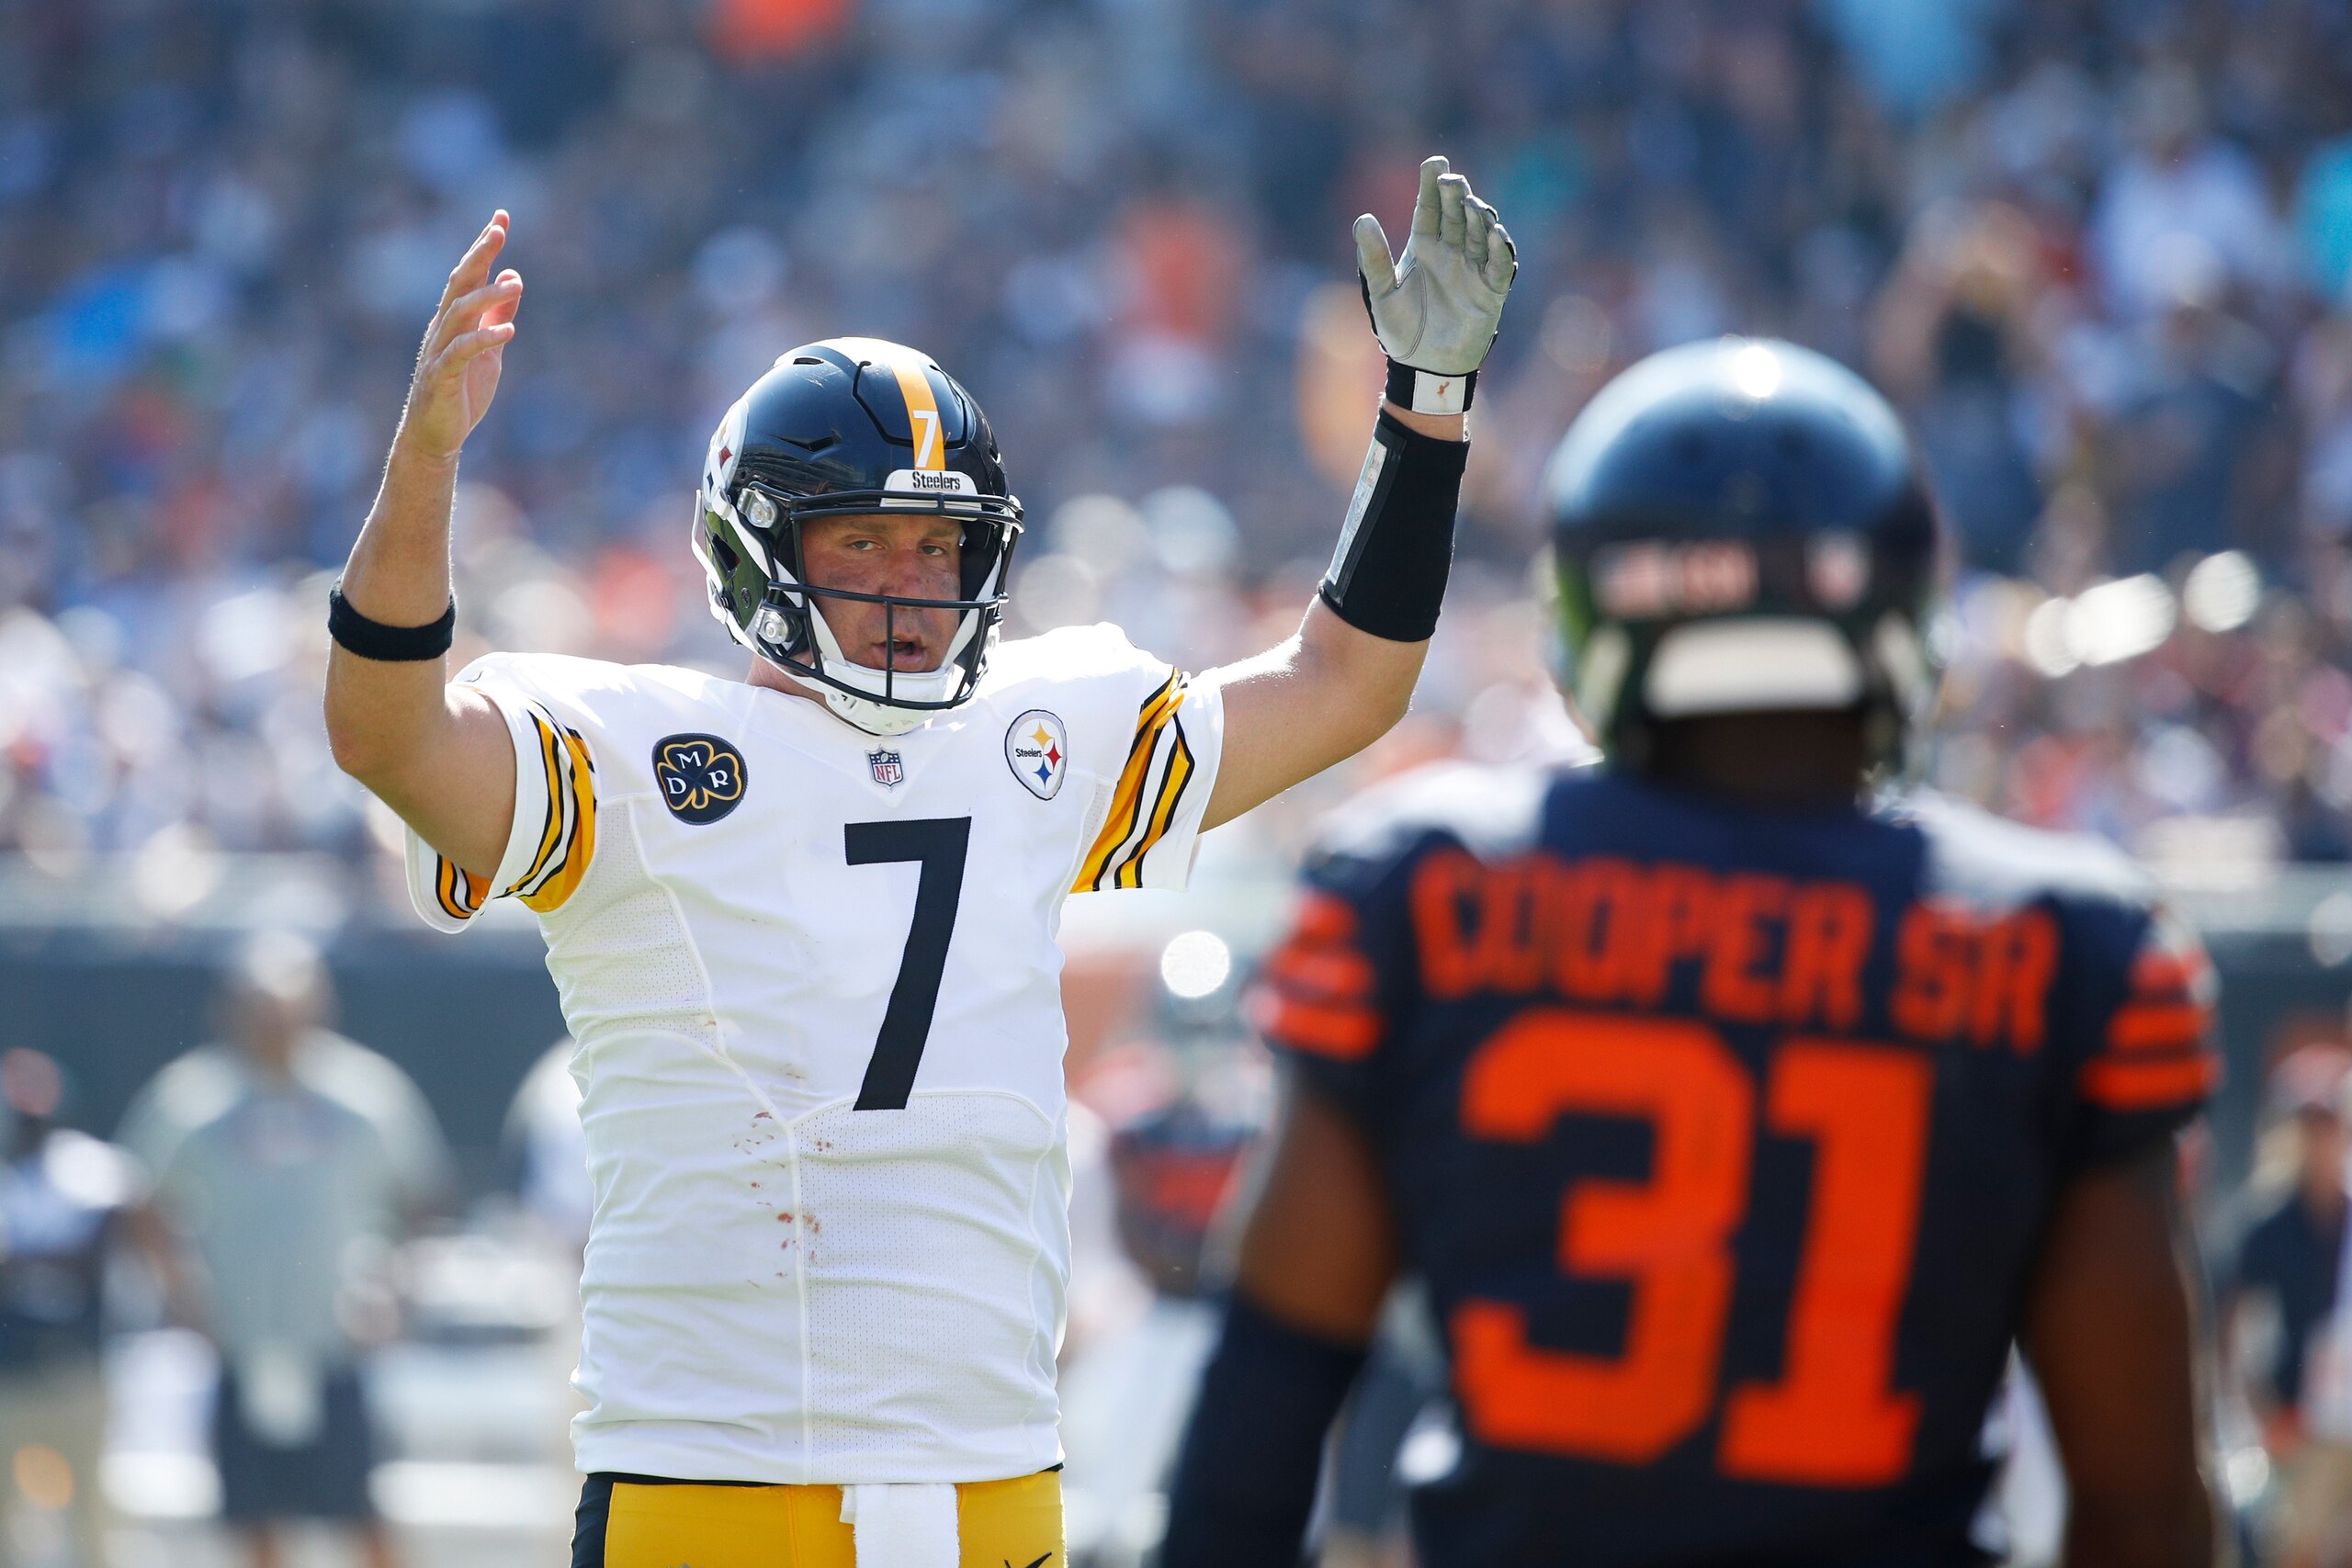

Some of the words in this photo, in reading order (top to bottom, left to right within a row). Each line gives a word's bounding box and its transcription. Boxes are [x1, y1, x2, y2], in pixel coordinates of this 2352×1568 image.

[912, 410, 938, 468] 7
[912, 470, 961, 490] Steelers
[875, 764, 901, 783] NFL
[1015, 748, 1043, 758] Steelers
[844, 816, 972, 1111] 7
[1408, 847, 1874, 1031] COOPER
[1888, 891, 2063, 1058] SR
[1450, 1008, 1937, 1488] 31
